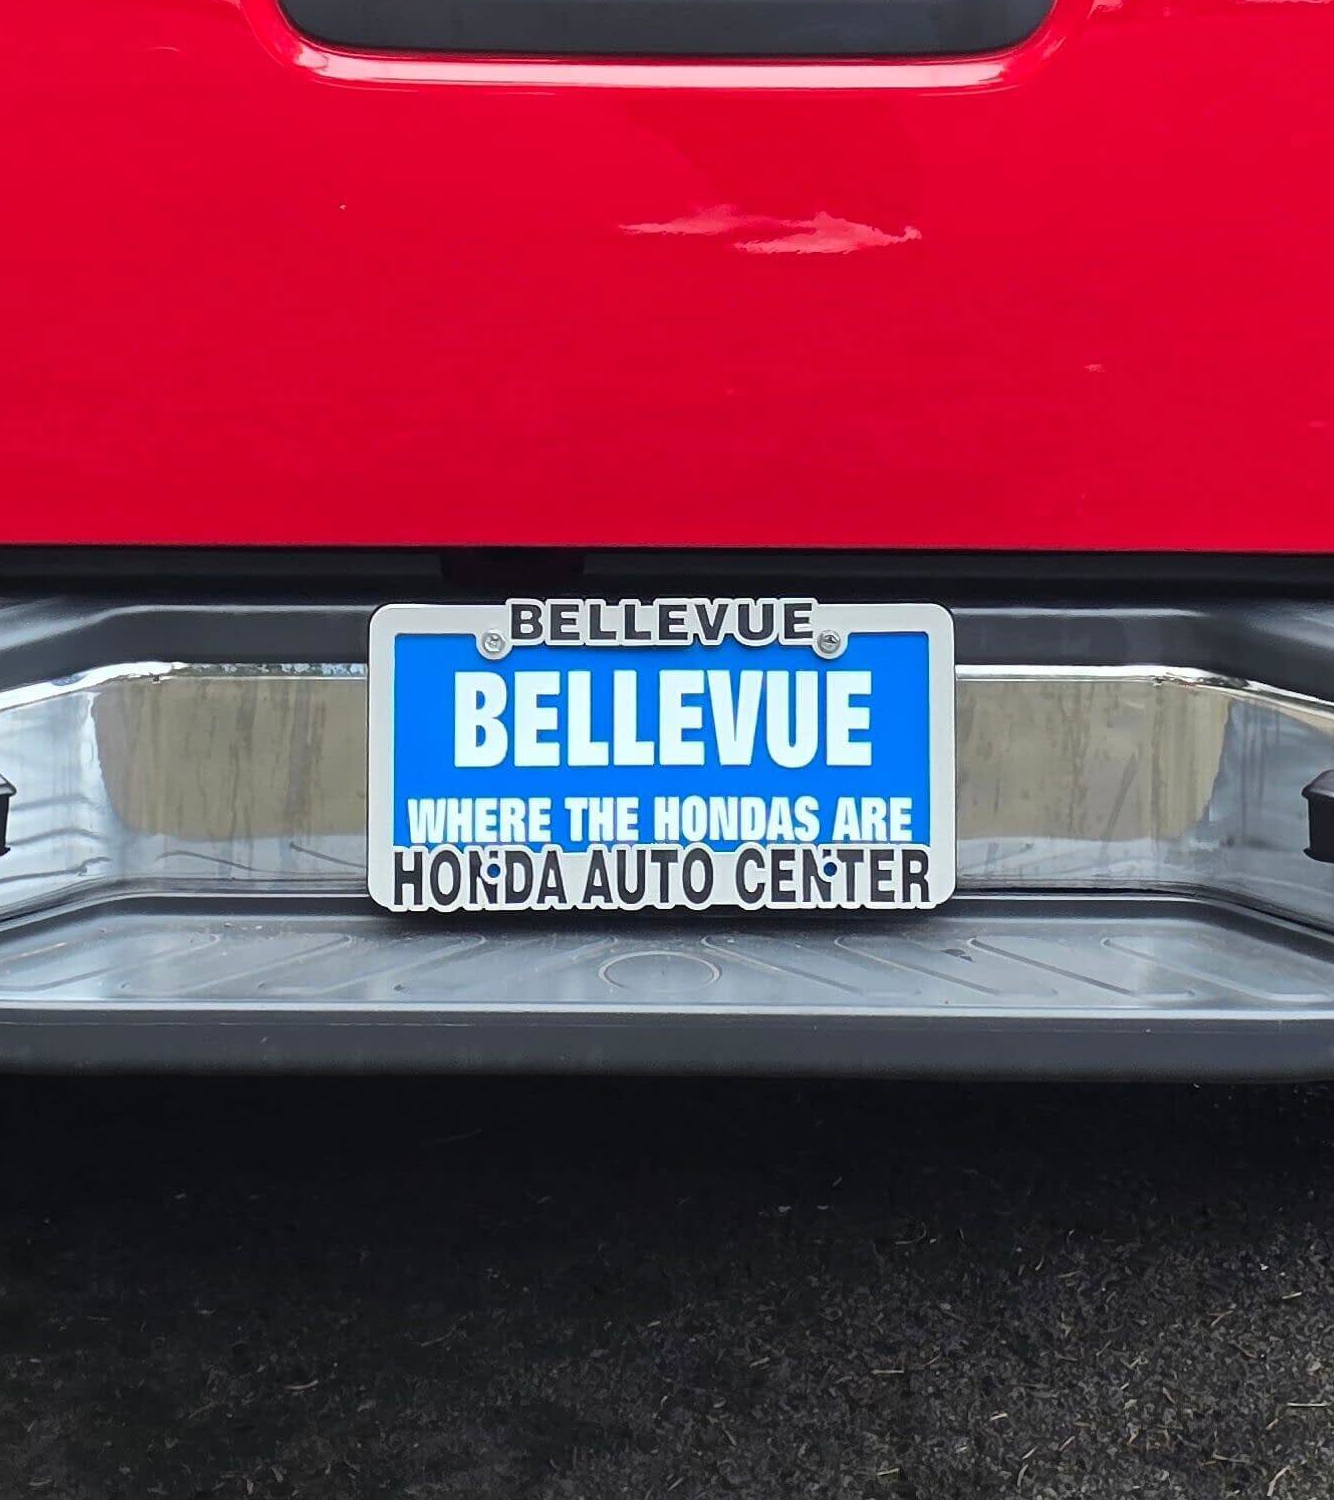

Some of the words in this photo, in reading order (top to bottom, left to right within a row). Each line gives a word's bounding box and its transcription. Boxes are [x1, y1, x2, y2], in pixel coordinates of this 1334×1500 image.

[510, 602, 815, 641] BELLEVUE
[454, 669, 873, 768] BELLEVUE
[407, 798, 553, 843] WHERE
[565, 797, 639, 843] THE
[653, 795, 820, 843] HONDAS
[832, 796, 913, 842] ARE
[393, 849, 570, 906] HONDA
[585, 848, 715, 904] AUTO
[735, 848, 931, 904] CENTER
